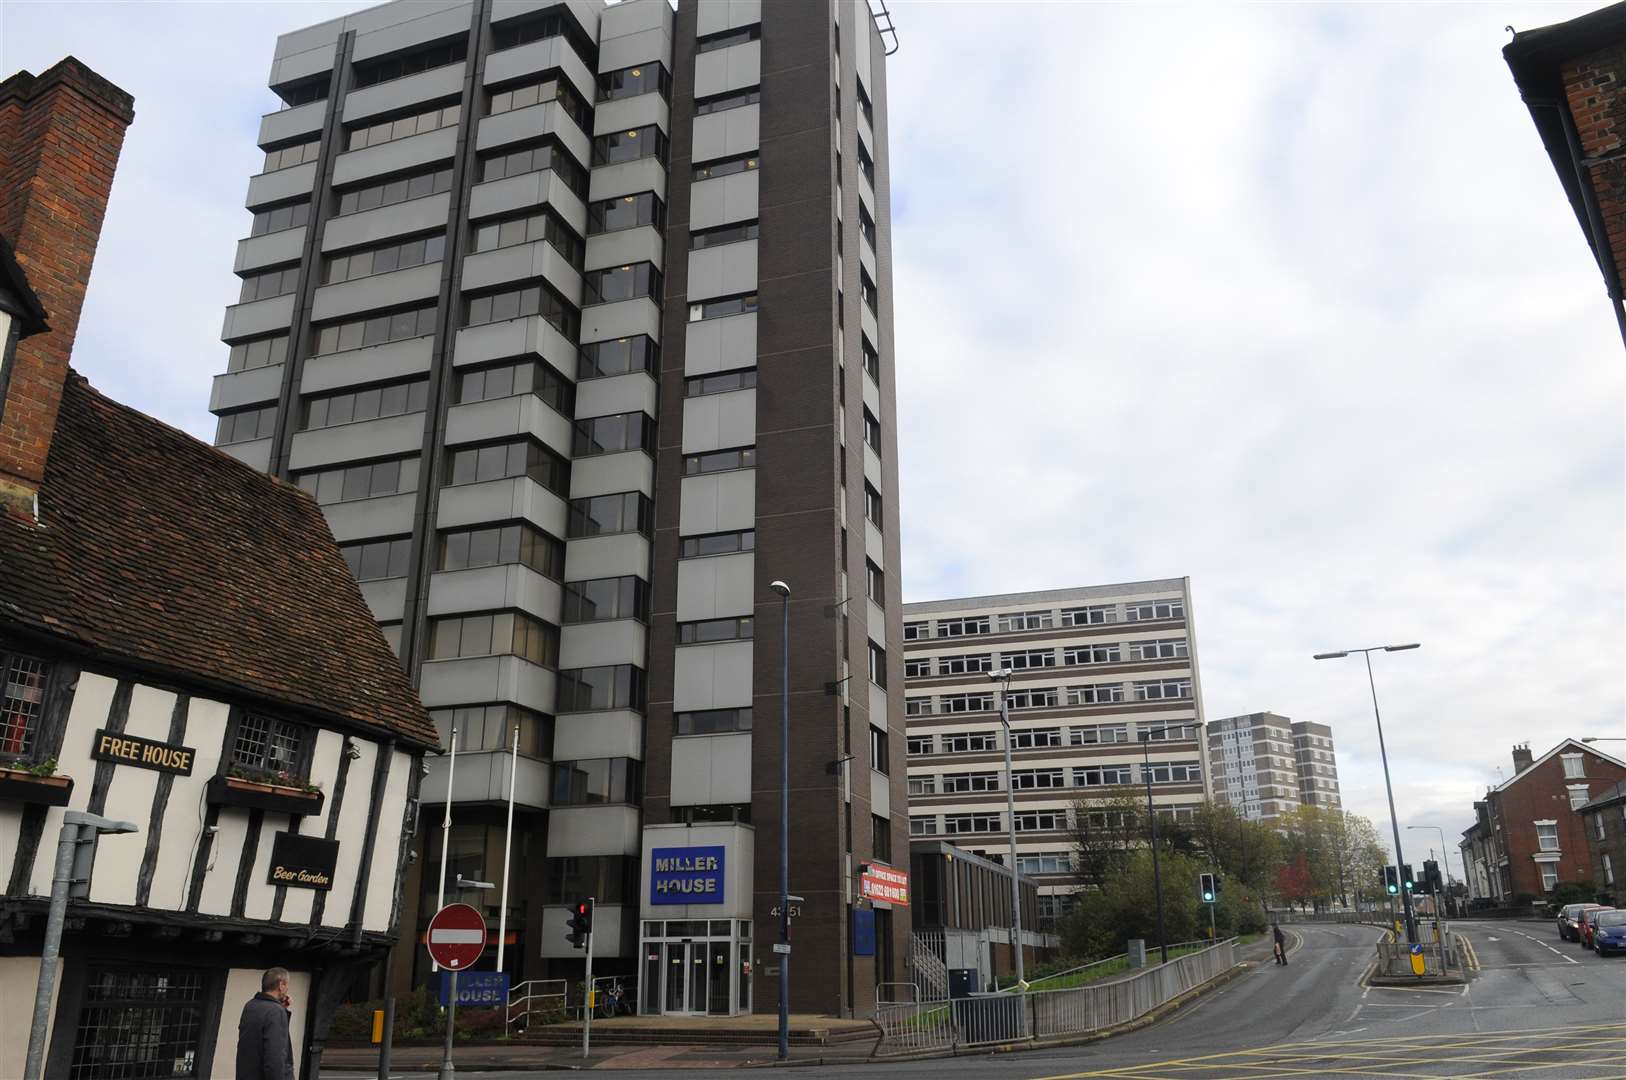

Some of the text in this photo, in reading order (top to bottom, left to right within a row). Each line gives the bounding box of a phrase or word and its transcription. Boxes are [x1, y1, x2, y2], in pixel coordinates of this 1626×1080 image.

[99, 735, 191, 770] FREE HOUSE
[655, 856, 719, 873] MILLER
[273, 866, 329, 885] Beer Garden
[656, 878, 717, 894] HOUSE
